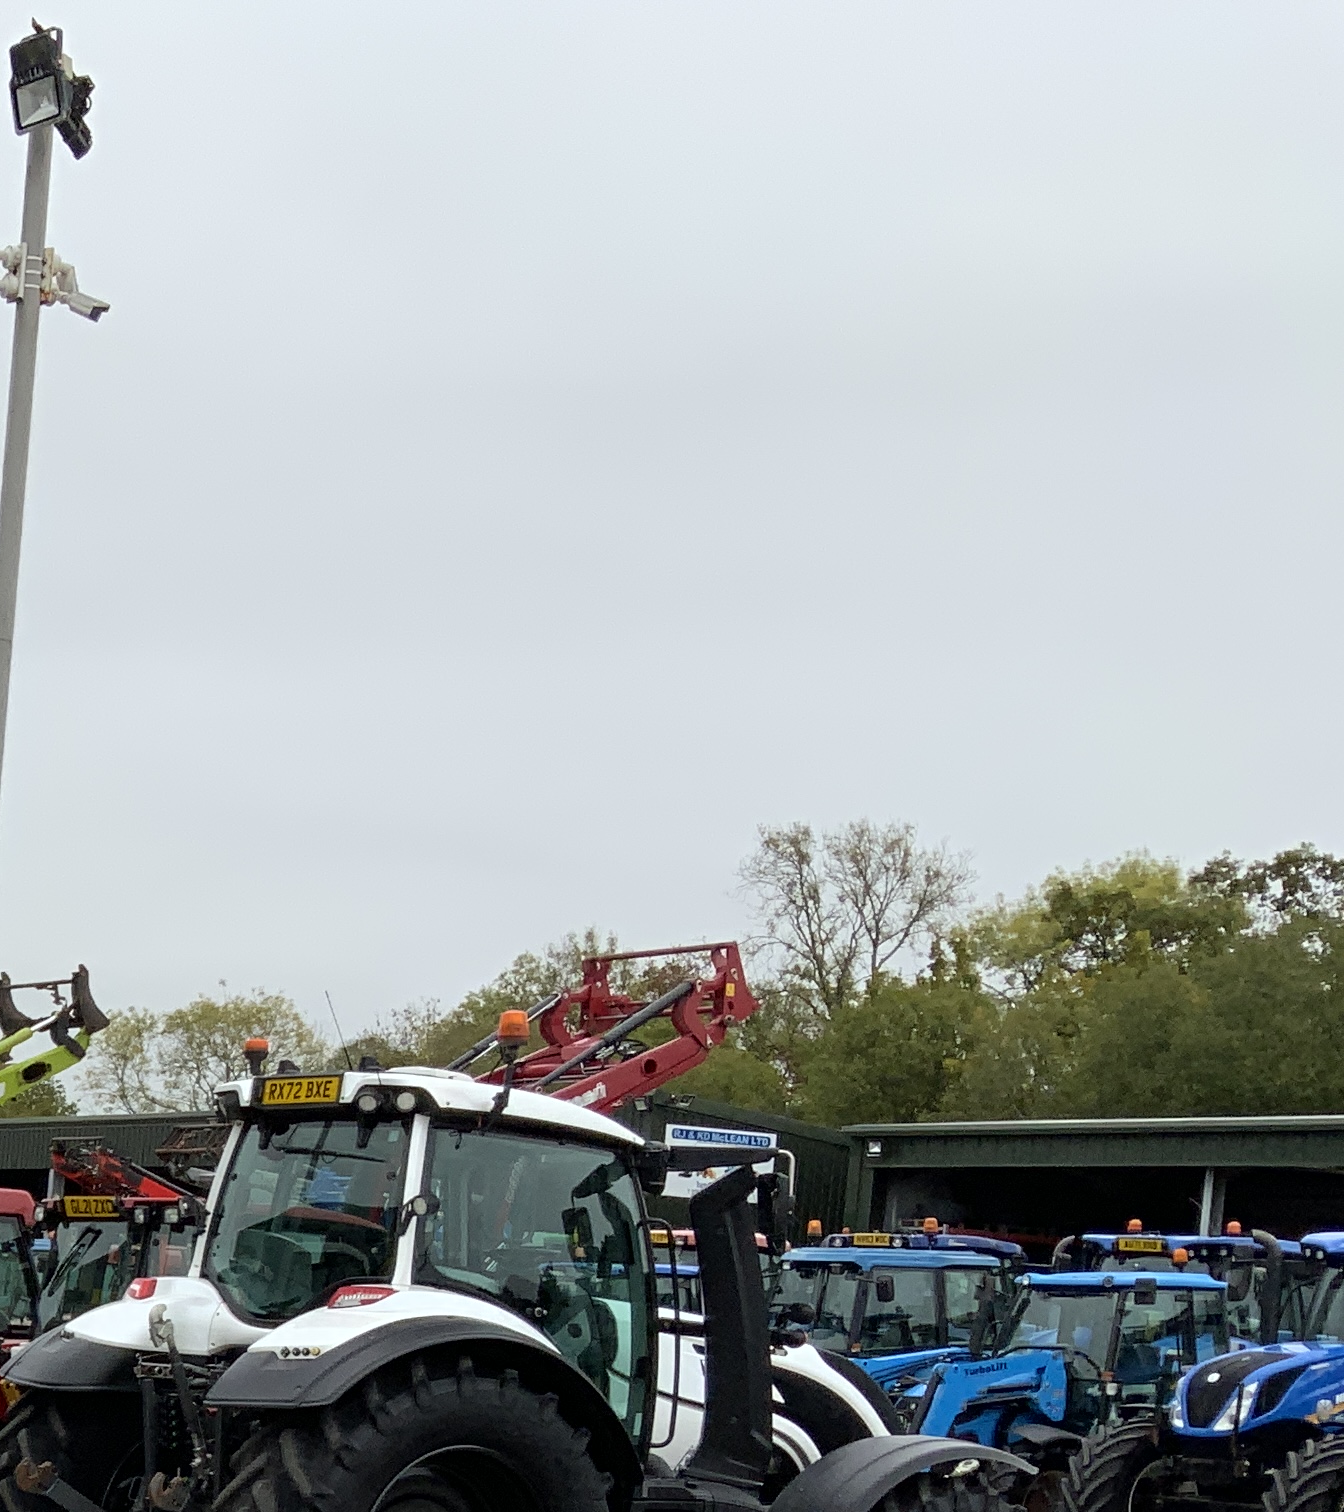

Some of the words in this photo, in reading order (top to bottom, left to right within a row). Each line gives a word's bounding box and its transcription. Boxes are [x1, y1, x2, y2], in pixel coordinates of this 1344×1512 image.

[268, 1081, 303, 1100] RX72
[304, 1080, 334, 1098] BXE
[673, 1128, 687, 1138] RJ
[687, 1131, 695, 1139] &
[750, 1136, 769, 1146] LTD
